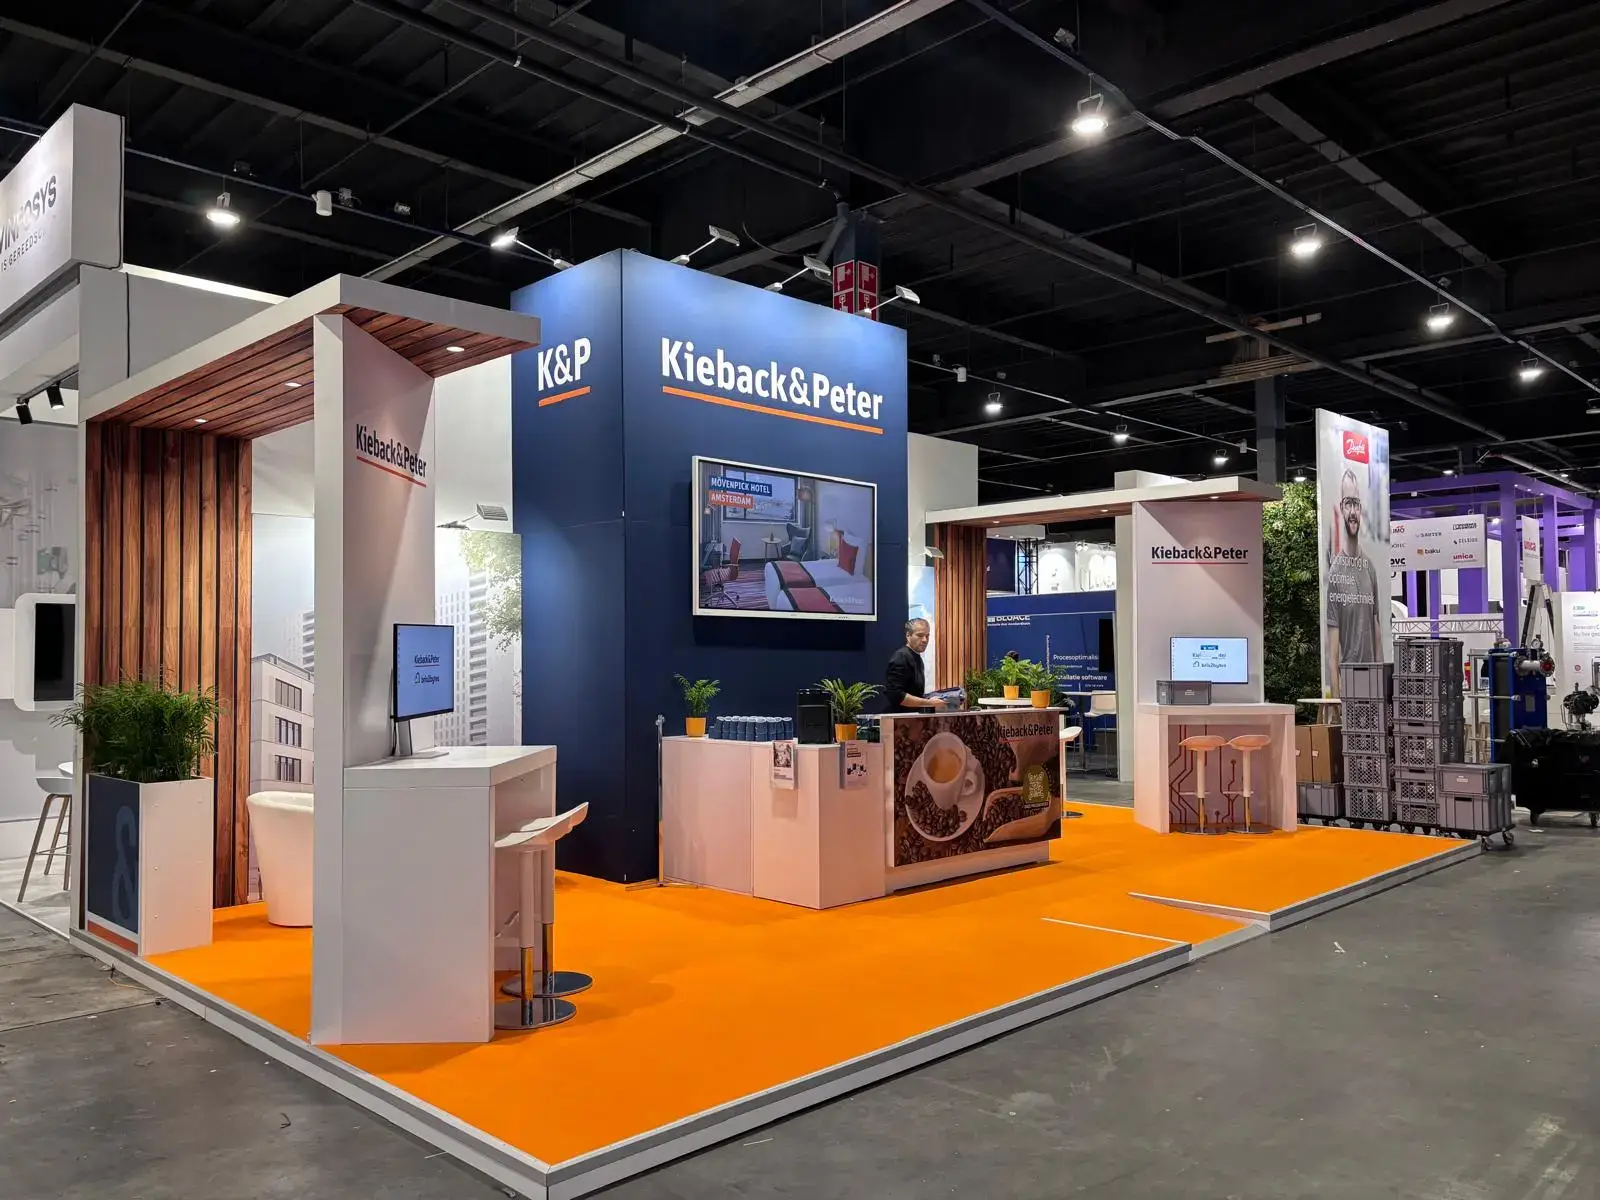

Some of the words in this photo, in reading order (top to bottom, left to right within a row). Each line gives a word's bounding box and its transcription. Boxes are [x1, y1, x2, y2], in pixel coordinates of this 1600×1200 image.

[538, 337, 591, 391] K&P
[661, 337, 883, 420] Kieback&Peter
[356, 423, 427, 478] Kieback&Peter
[711, 476, 749, 491] MÖVENPICK
[750, 483, 770, 493] HOTEL
[711, 493, 751, 505] AMSTERDAM
[1151, 546, 1248, 560] Kieback&Peter
[1329, 592, 1375, 607] energietechniek
[998, 724, 1054, 739] Kieback&Peter
